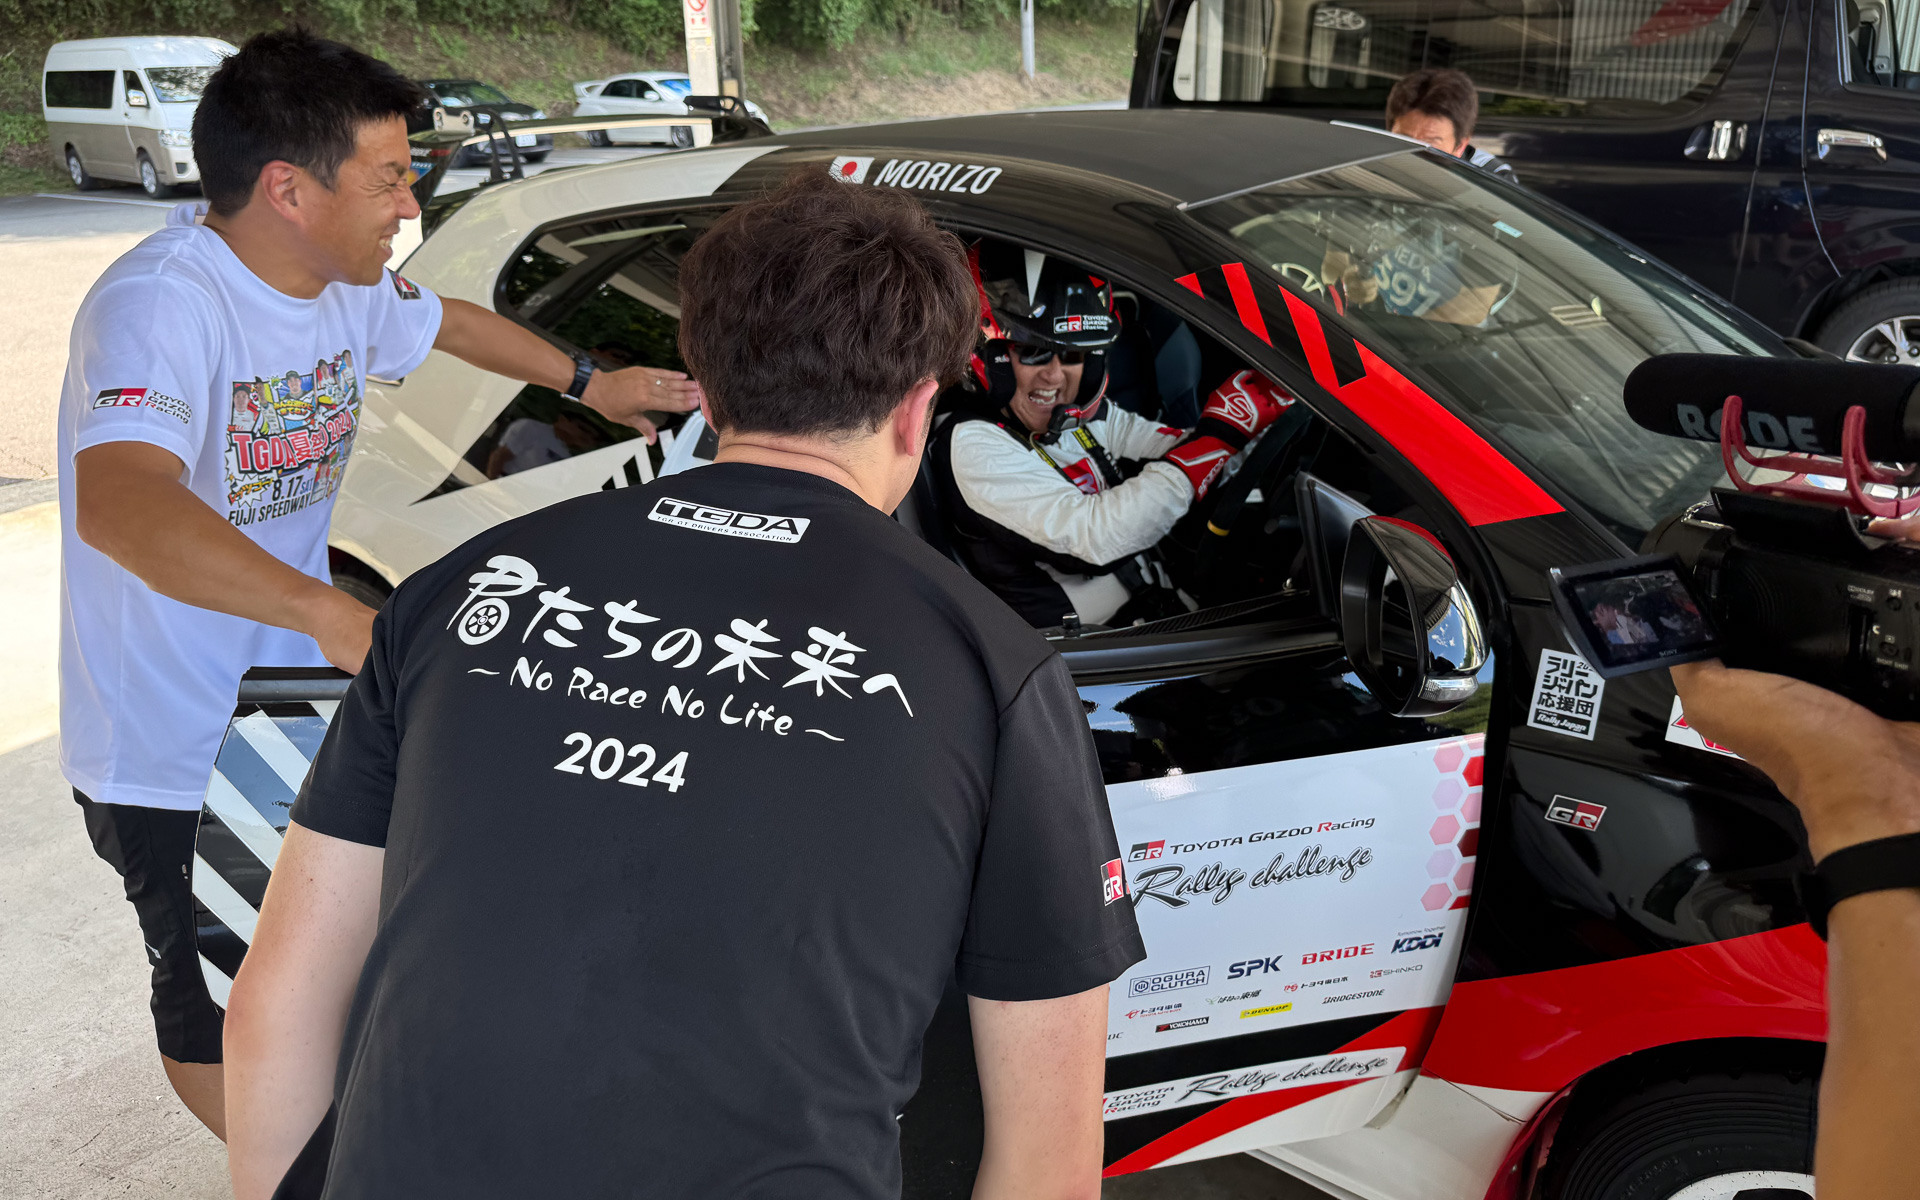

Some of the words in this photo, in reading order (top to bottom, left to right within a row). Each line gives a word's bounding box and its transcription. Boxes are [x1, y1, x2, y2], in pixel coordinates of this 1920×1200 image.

[873, 159, 1003, 195] MORIZO
[1055, 320, 1081, 332] GR
[145, 401, 189, 424] Racing
[148, 396, 191, 418] GAZOO
[152, 389, 193, 414] TOYOTA
[272, 475, 304, 501] 8.17
[300, 478, 314, 494] SAT
[229, 508, 256, 526] FUJI
[258, 493, 311, 522] SPEEDWAY
[657, 499, 799, 535] TGDA
[691, 523, 729, 533] DRIVERS
[732, 530, 793, 541] ASSOCIATION
[446, 555, 914, 718] 君たちの未来へ
[1546, 656, 1589, 678] ラリー
[509, 656, 553, 692] No
[567, 666, 647, 709] Race
[661, 685, 705, 719] No
[719, 694, 793, 736] Life
[1542, 674, 1598, 698] ジャパン
[1537, 692, 1594, 717] 応援団
[1537, 714, 1561, 726] Rally
[1560, 719, 1587, 732] Japan
[553, 731, 689, 793] 2024
[1549, 805, 1598, 829] GR
[1130, 845, 1163, 861] GR
[1170, 836, 1243, 855] TOYOTA
[1248, 825, 1313, 843] GAZOO
[1316, 817, 1376, 832] Racing
[1133, 861, 1247, 909] Rally
[1249, 843, 1373, 889] challenge
[1104, 874, 1122, 902] GR
[1302, 943, 1375, 965] BRIDE
[1390, 932, 1444, 954] KDDI
[1151, 970, 1205, 984] OGURA
[1227, 955, 1283, 980] SPK
[1383, 964, 1423, 976] SHINKO
[1151, 977, 1205, 992] CLUTCH
[1322, 988, 1385, 1004] BRIDGESTONE
[1250, 1004, 1289, 1015] DUNLOP
[1169, 1018, 1208, 1029] YOKOHAMA
[1176, 1070, 1281, 1104] Rally
[1280, 1056, 1388, 1083] challenge
[1107, 1093, 1166, 1108] GAZOO
[1112, 1086, 1175, 1101] TOYOTA
[1104, 1099, 1161, 1114] Racing
